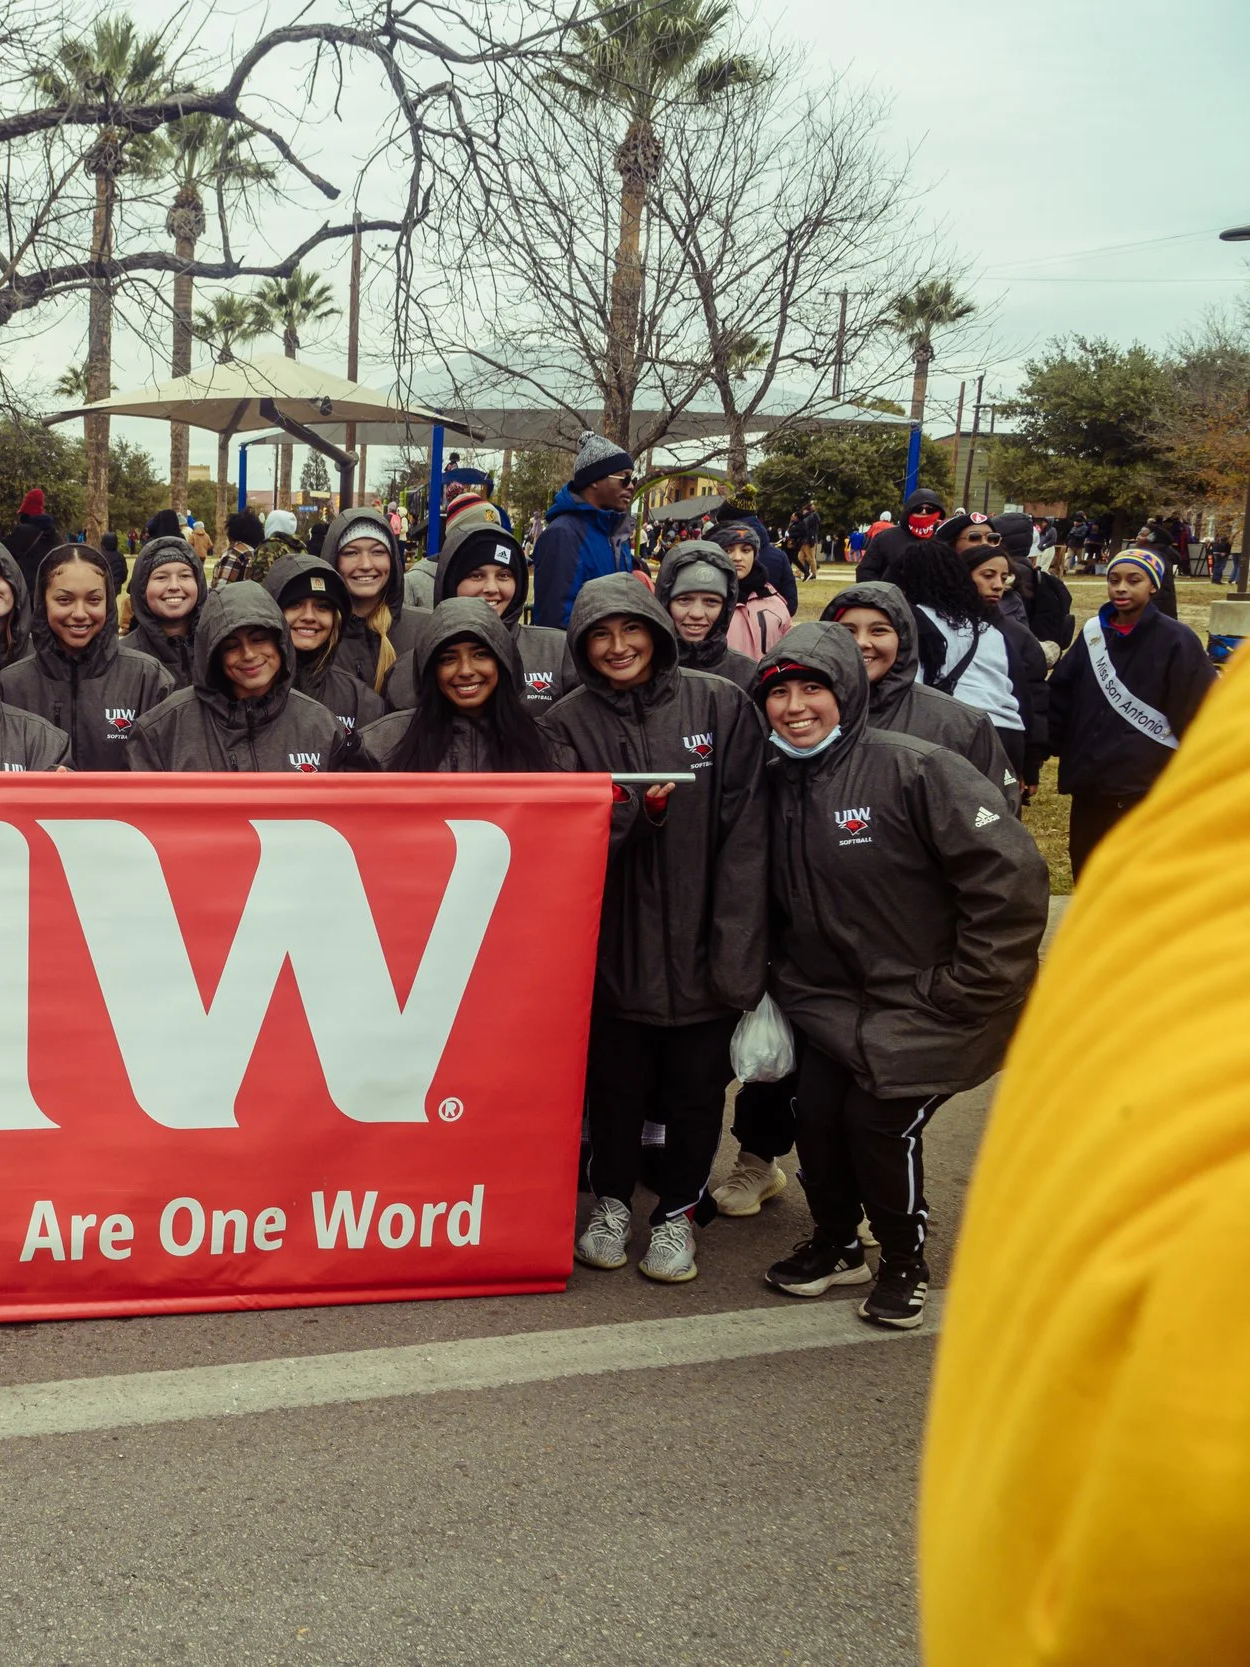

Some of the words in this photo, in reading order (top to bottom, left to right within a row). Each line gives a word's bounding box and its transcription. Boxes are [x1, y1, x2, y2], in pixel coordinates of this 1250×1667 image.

[523, 671, 554, 683] UIW
[1096, 656, 1109, 682] Miss
[1105, 679, 1122, 703] San
[1119, 701, 1163, 735] Antonio
[105, 708, 136, 721] UIW
[682, 732, 713, 749] UIW
[288, 752, 321, 766] UIW
[833, 806, 871, 825] UIW
[838, 837, 872, 847] SOFTBALL
[19, 1200, 135, 1262] Are
[159, 1196, 287, 1257] One
[311, 1184, 485, 1249] Word
